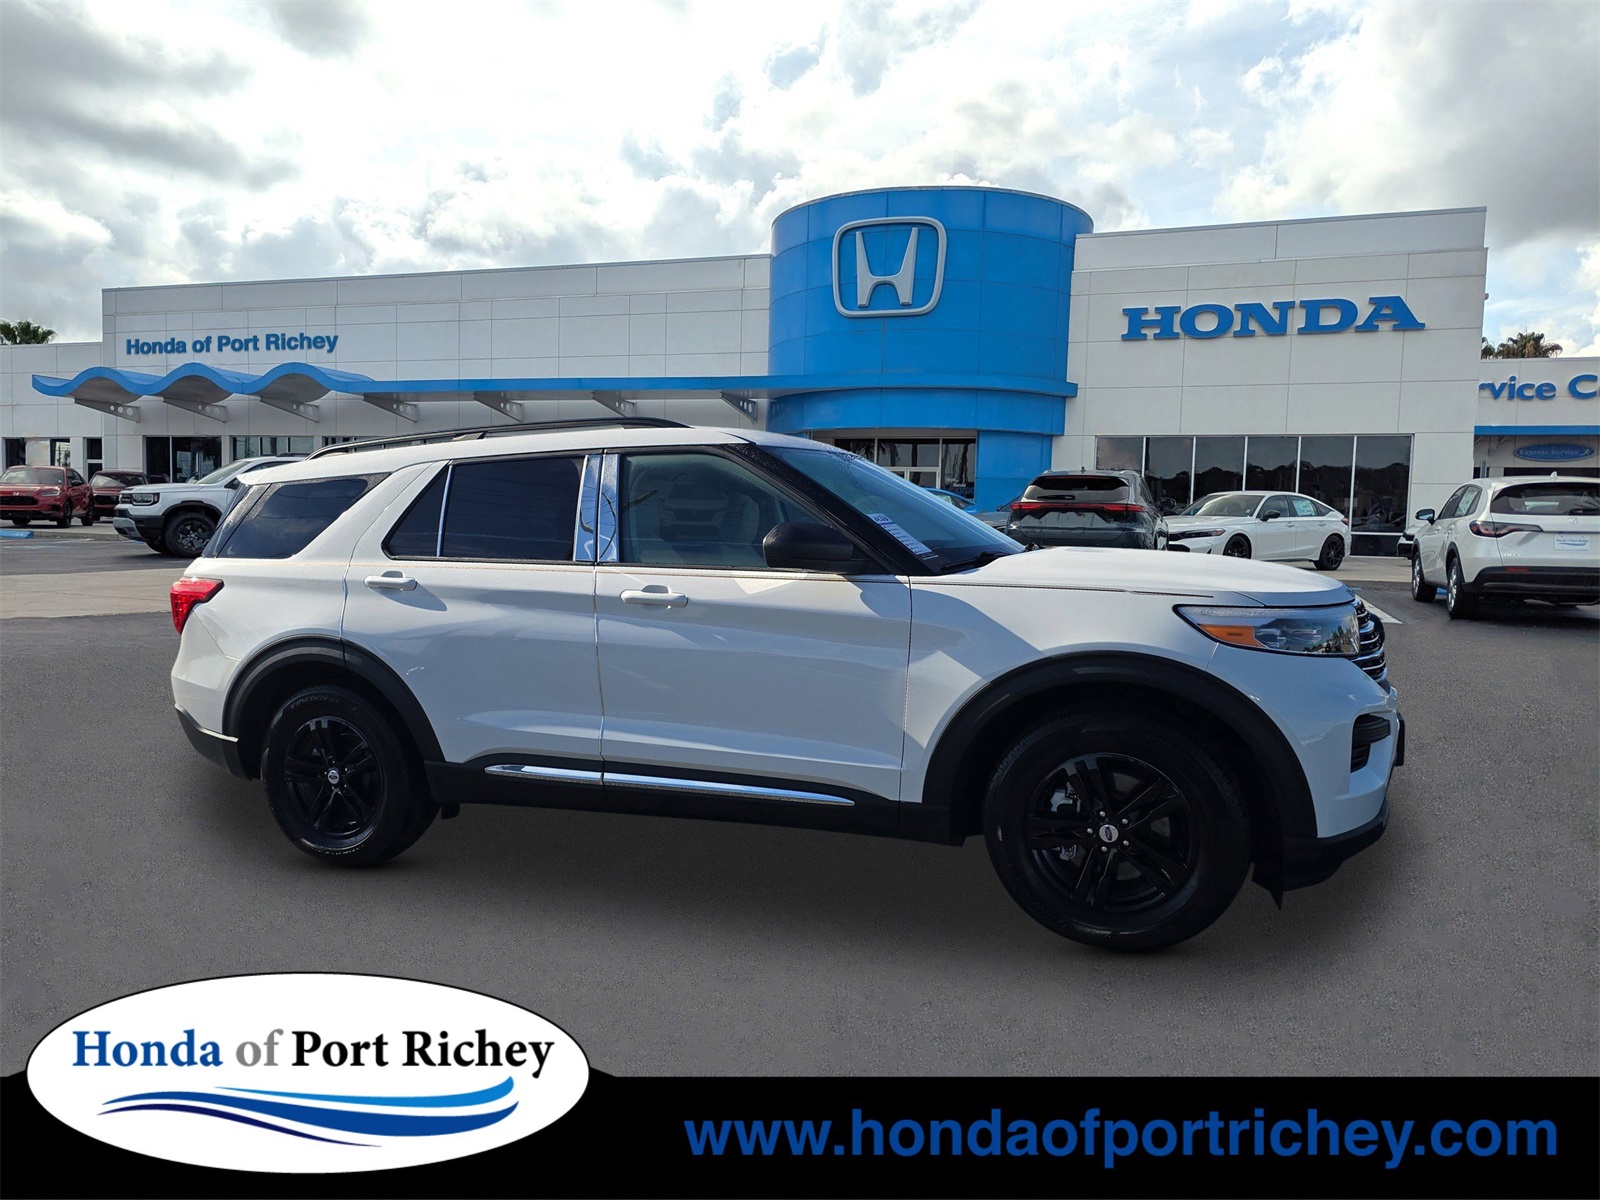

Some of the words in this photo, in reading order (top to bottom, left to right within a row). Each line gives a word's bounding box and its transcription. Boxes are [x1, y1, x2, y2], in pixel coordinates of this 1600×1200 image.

[1121, 296, 1426, 340] HONDA
[126, 337, 187, 355] Honda
[191, 336, 212, 353] of
[217, 334, 260, 353] Port
[266, 332, 339, 353] Richey
[1568, 373, 1600, 400] C
[1519, 449, 1549, 457] Express
[1550, 448, 1578, 456] Service
